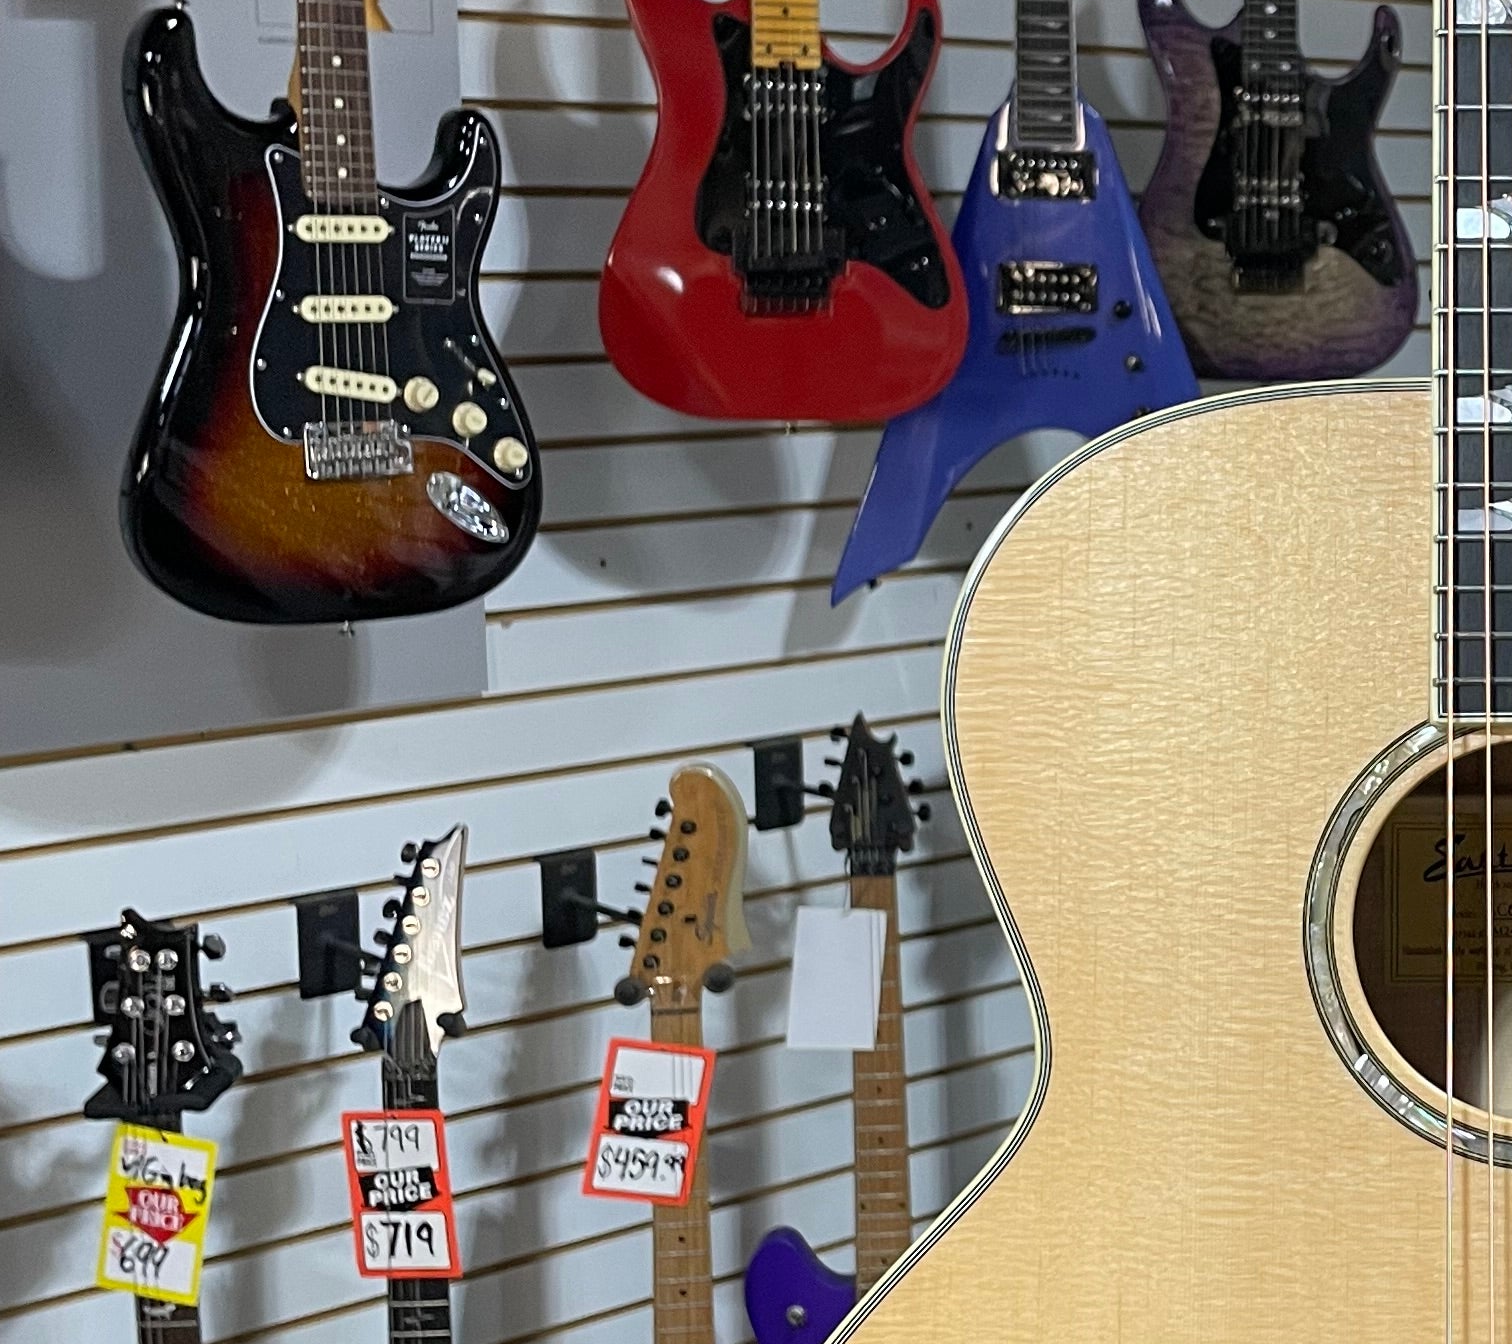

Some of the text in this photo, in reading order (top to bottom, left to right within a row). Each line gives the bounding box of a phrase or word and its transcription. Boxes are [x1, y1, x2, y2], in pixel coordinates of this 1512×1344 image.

[623, 1098, 675, 1117] OUR
[612, 1112, 685, 1133] PRICE
[373, 1168, 421, 1191] OUR
[136, 1188, 181, 1214] OUR
[367, 1181, 434, 1209] PRICE
[365, 1219, 436, 1262] $719
